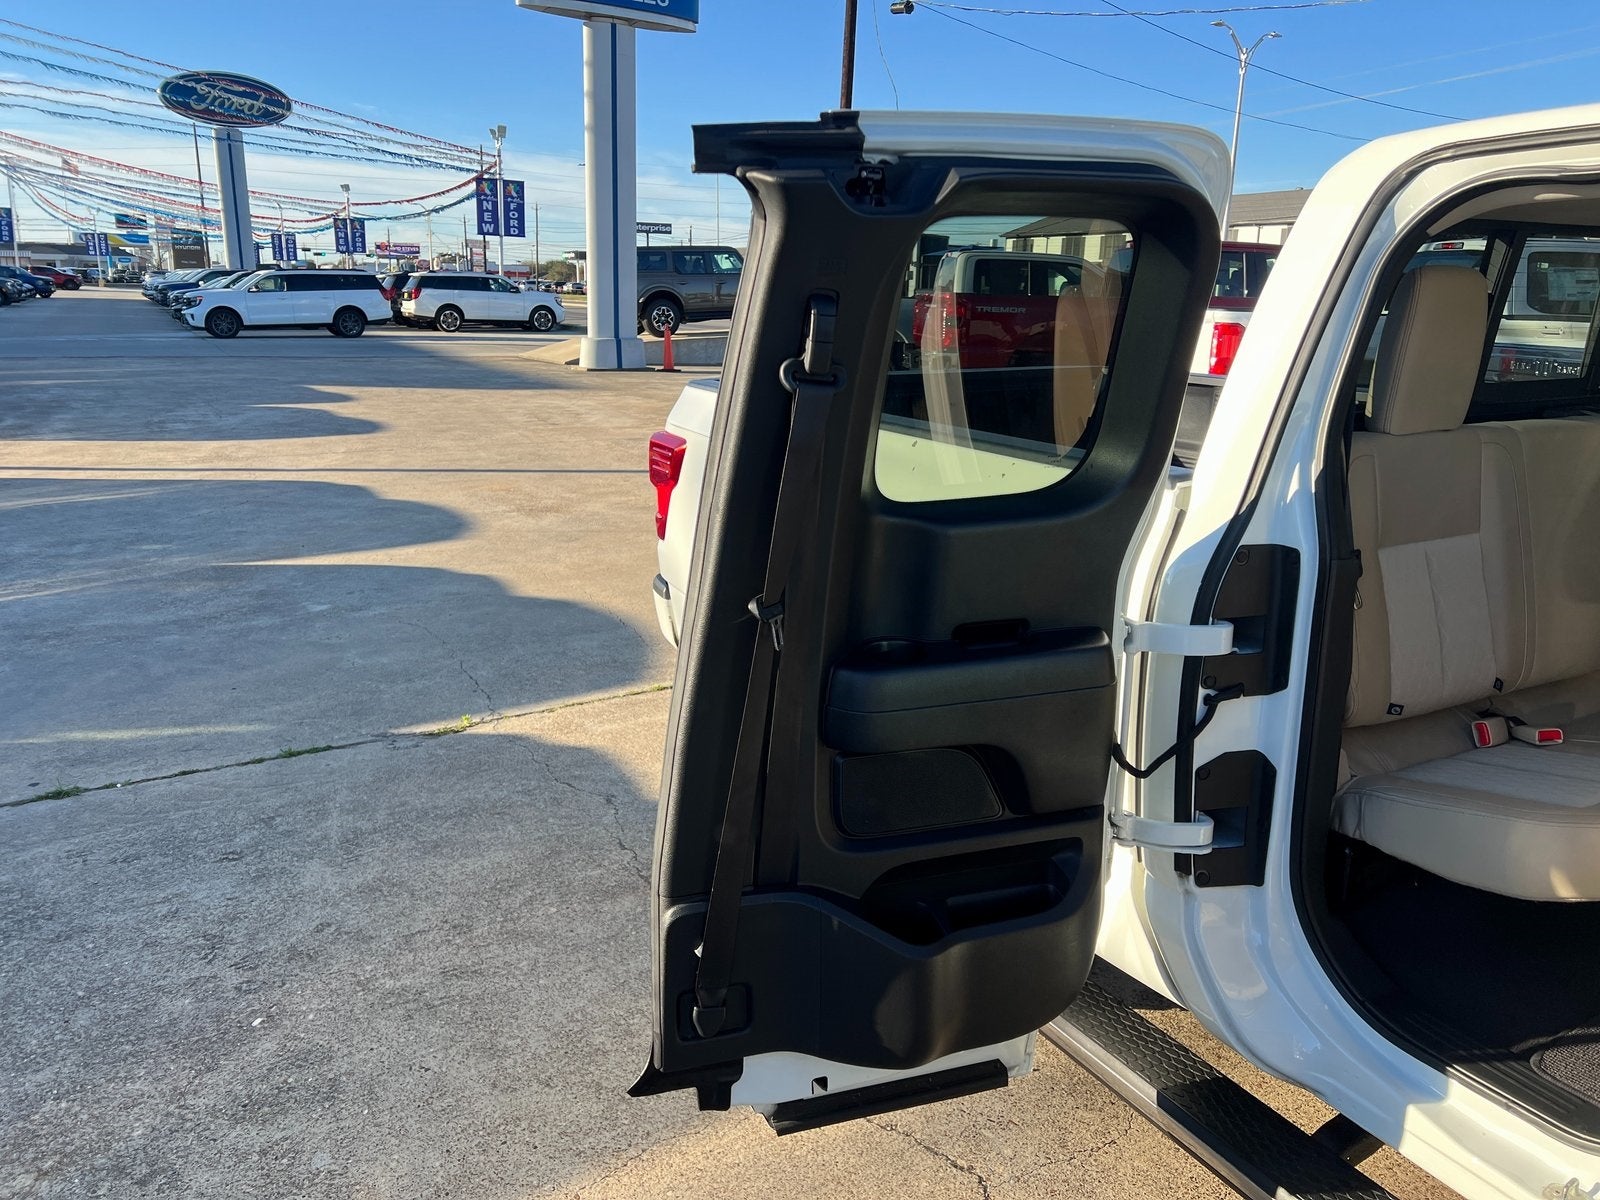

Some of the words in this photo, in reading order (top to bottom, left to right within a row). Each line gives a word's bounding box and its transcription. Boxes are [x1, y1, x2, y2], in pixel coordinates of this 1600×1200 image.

[190, 81, 265, 116] Ford
[482, 201, 494, 233] NEW
[509, 203, 519, 235] FORD
[1, 220, 10, 241] FORD
[338, 231, 347, 252] NEW
[355, 232, 363, 252] FORD
[975, 305, 1027, 314] TREMOR
